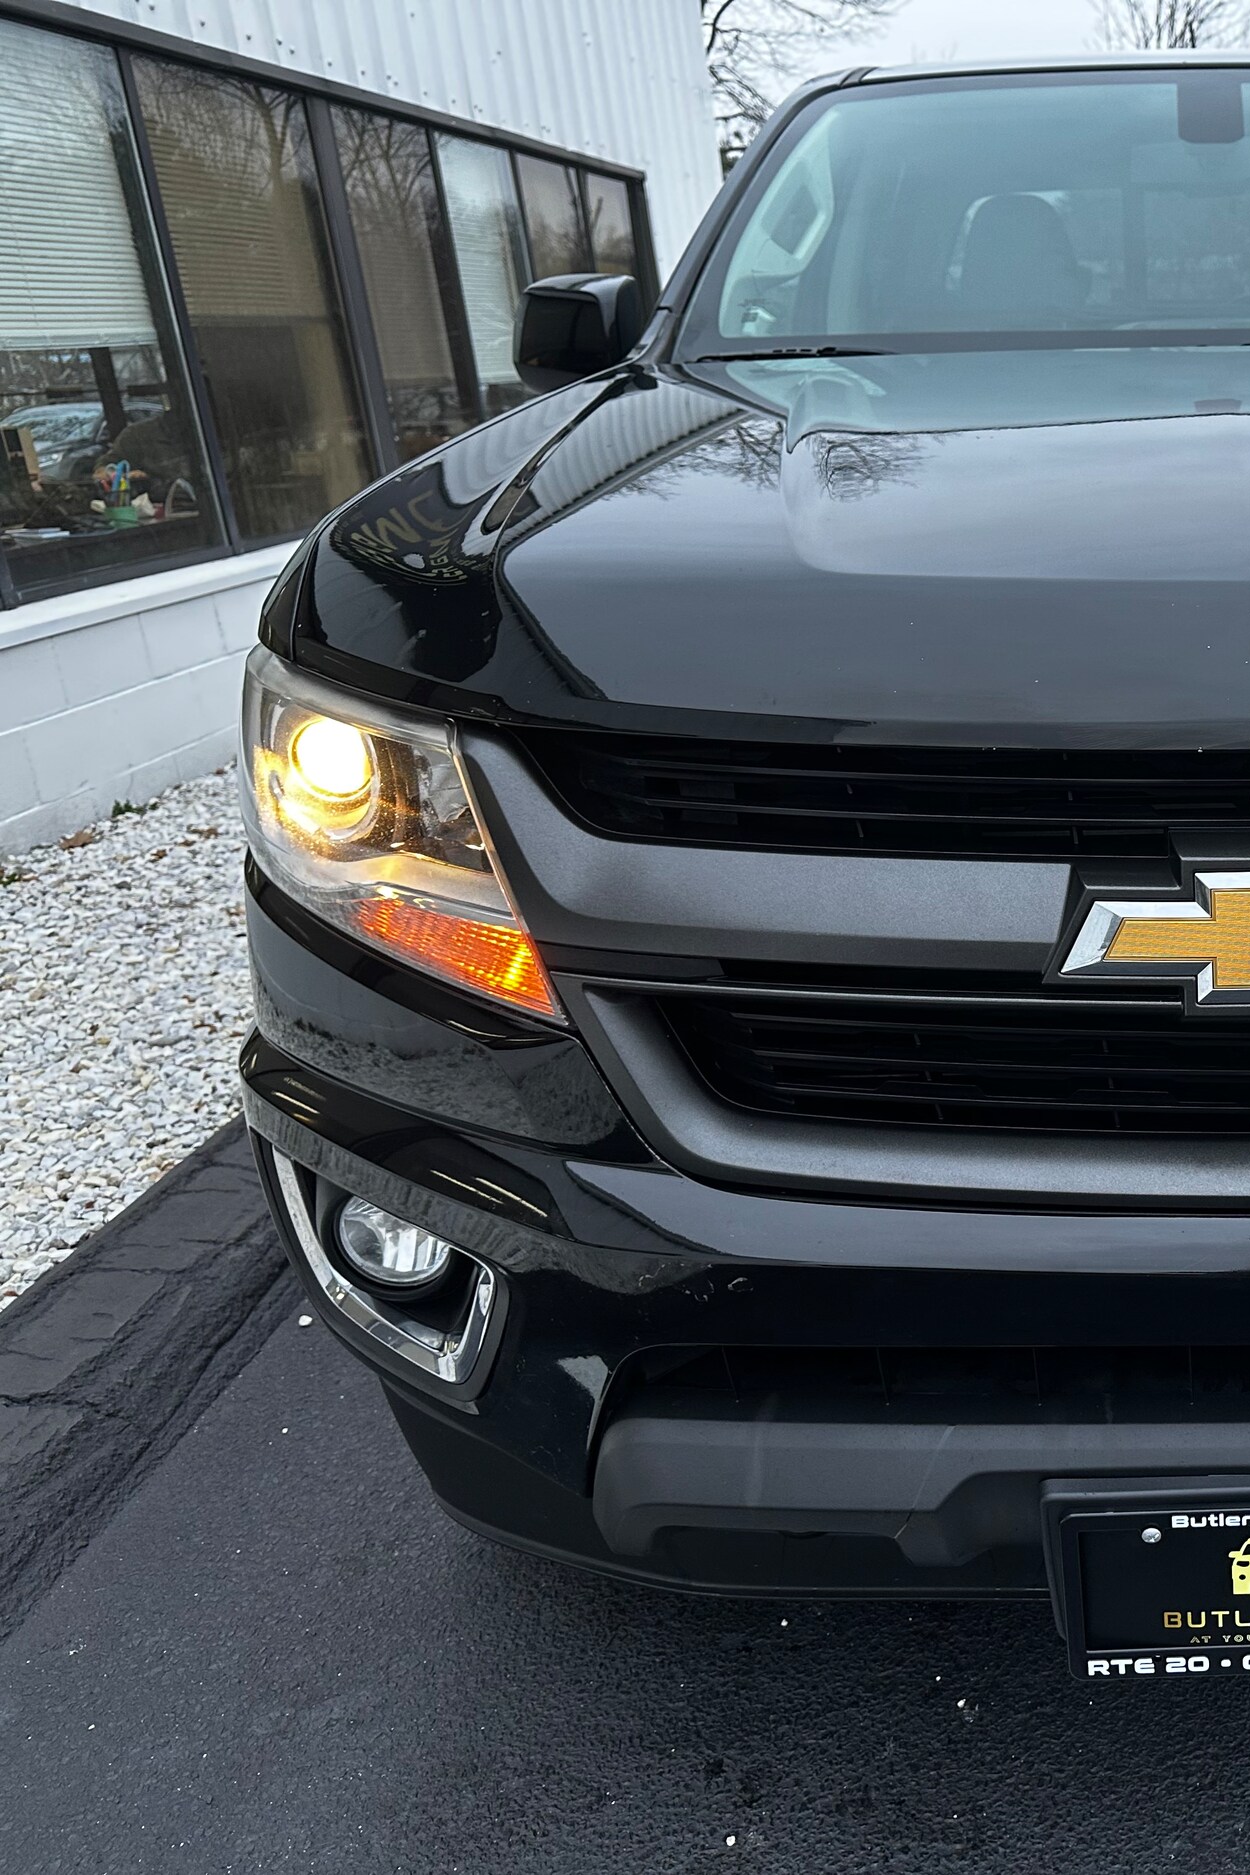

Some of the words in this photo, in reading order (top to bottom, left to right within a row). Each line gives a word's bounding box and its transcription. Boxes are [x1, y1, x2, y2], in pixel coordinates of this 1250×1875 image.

[1189, 1635, 1211, 1644] AT
[1087, 1657, 1155, 1676] RTE
[1165, 1655, 1210, 1673] 20
